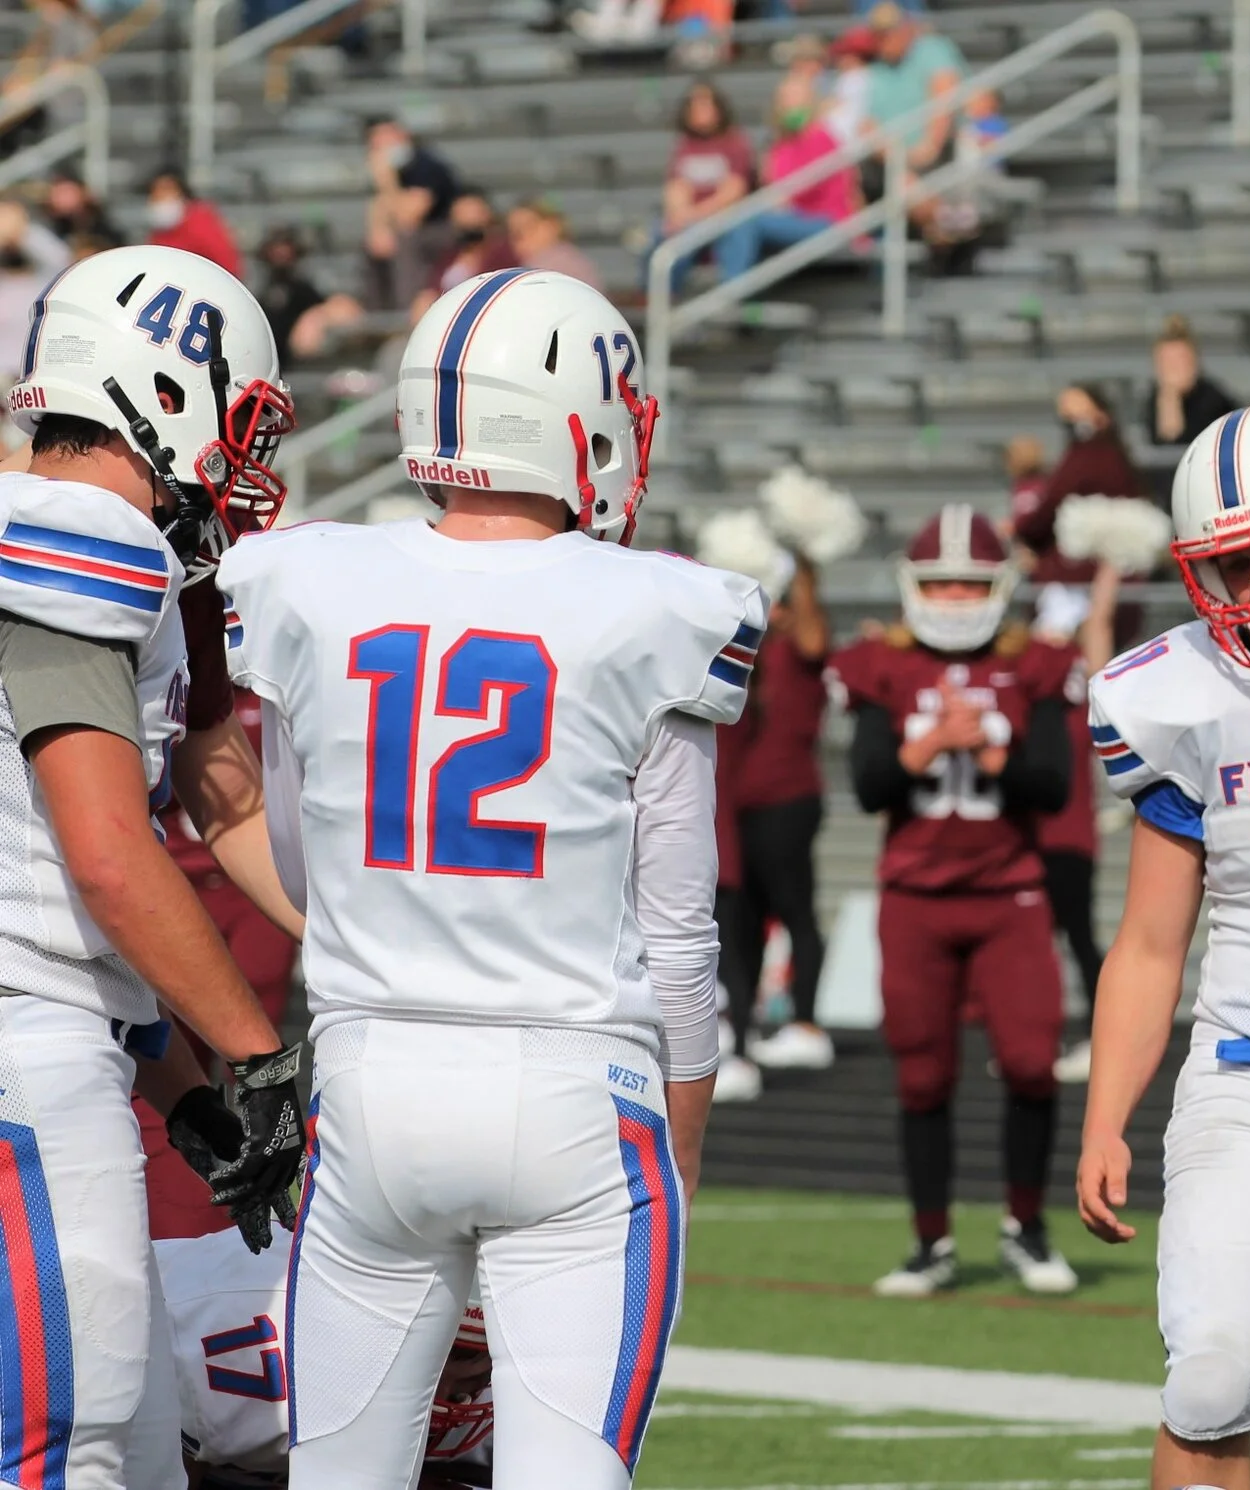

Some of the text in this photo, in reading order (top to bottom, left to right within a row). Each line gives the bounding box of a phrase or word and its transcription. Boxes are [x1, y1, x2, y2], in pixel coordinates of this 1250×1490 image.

[133, 283, 227, 367] 48
[11, 386, 47, 412] ddell
[591, 330, 639, 406] 12
[407, 458, 492, 489] Riddell
[347, 622, 558, 879] 12
[608, 1063, 648, 1095] WEST
[263, 1100, 292, 1157] adidas
[200, 1313, 287, 1403] 17
